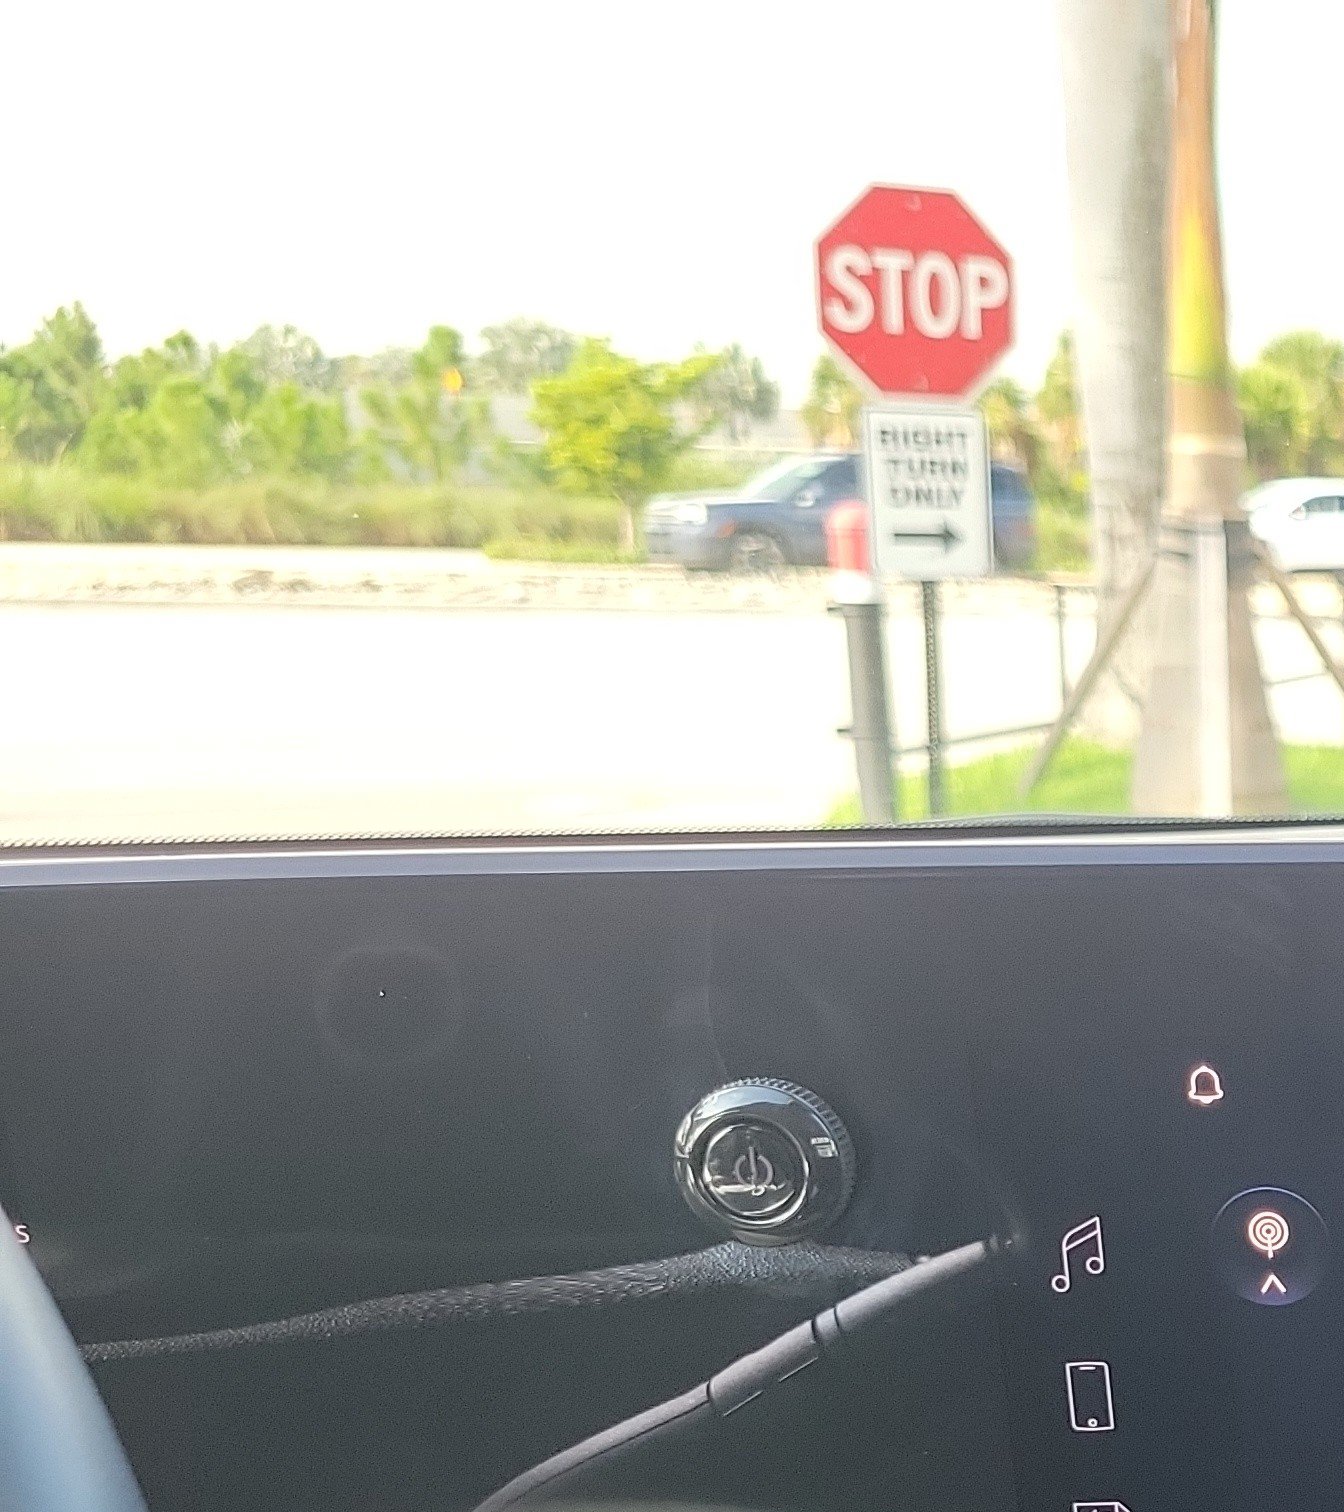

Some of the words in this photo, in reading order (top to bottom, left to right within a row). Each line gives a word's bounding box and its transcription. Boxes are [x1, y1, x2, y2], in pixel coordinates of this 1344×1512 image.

[823, 244, 1009, 341] STOP
[879, 427, 967, 450] RIGHT
[885, 456, 968, 480] TURN
[887, 486, 964, 509] ONLY
